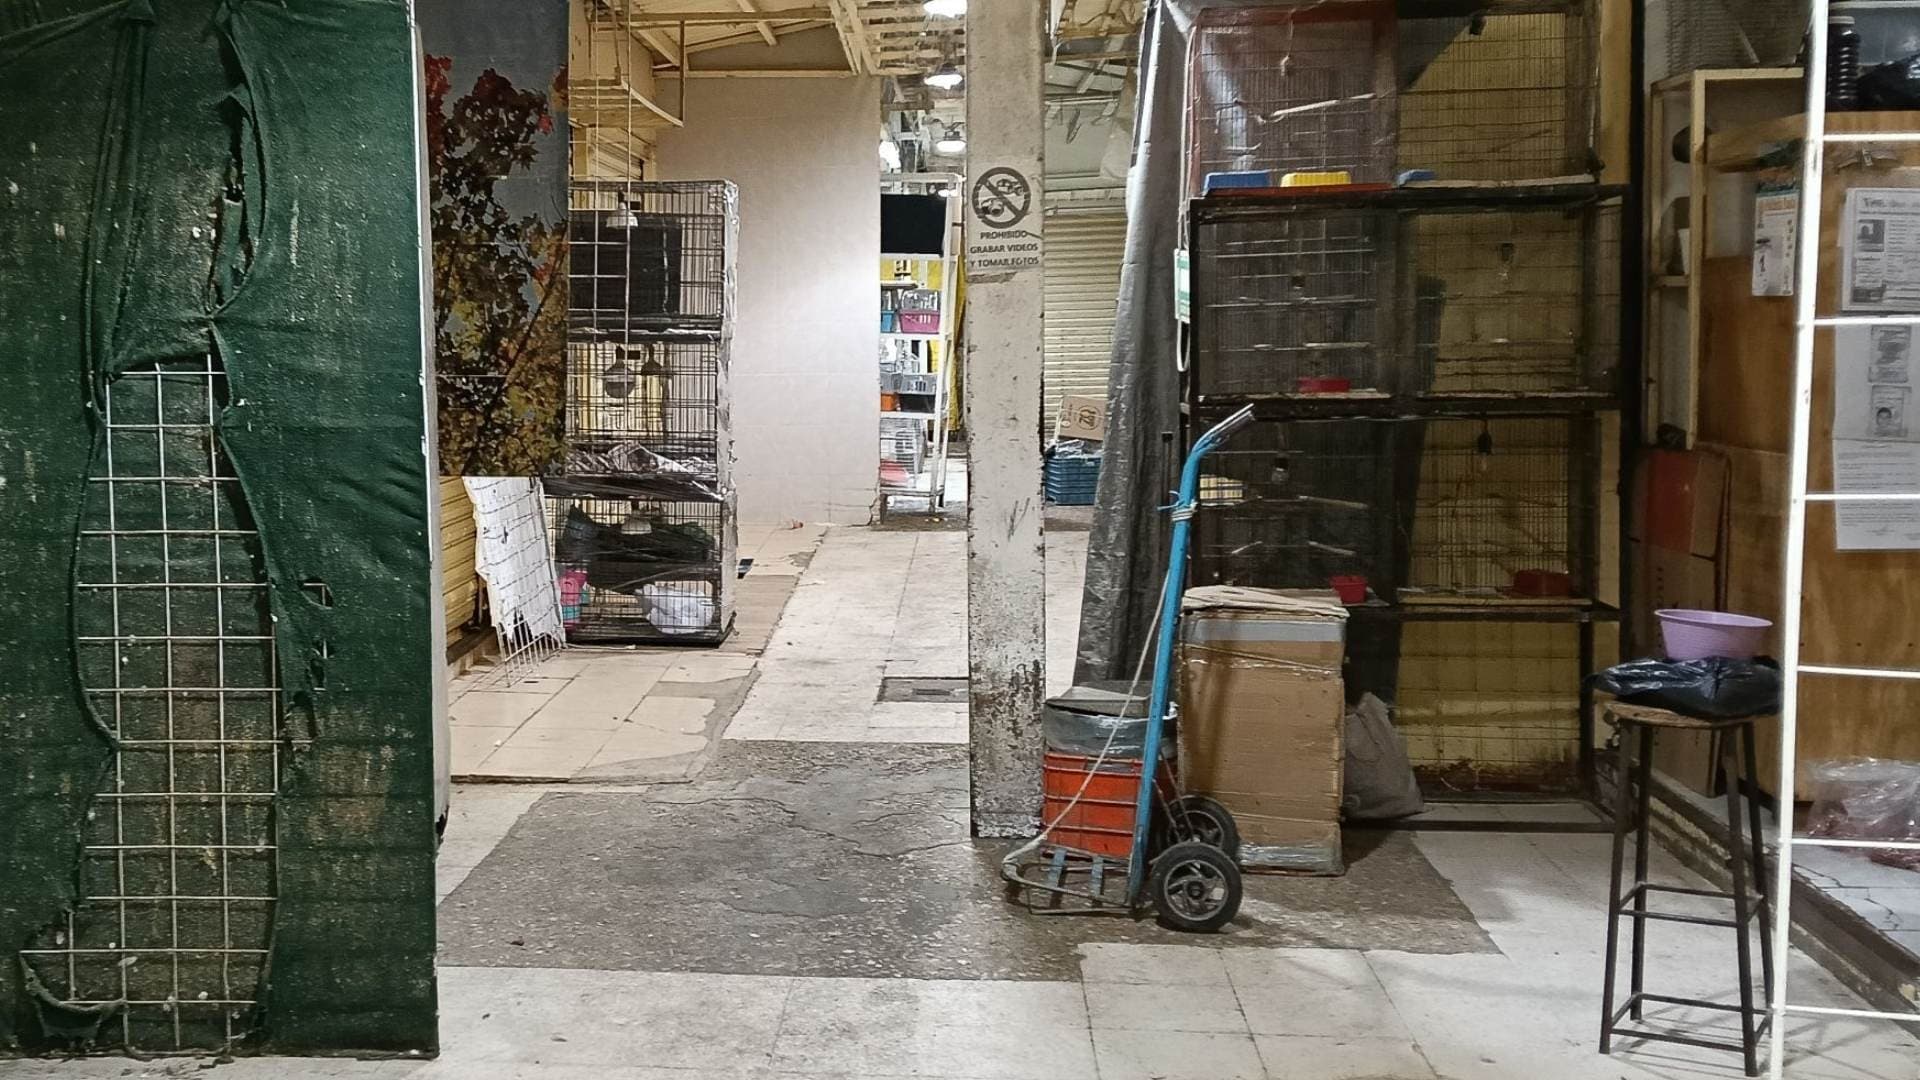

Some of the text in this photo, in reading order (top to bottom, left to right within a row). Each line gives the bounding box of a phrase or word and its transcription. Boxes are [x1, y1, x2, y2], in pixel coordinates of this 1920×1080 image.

[980, 230, 1027, 239] PROHIBIDO
[970, 243, 1039, 253] GRABAR VIDEOS
[978, 258, 1010, 267] TOMAR
[1011, 257, 1039, 266] FOTOS
